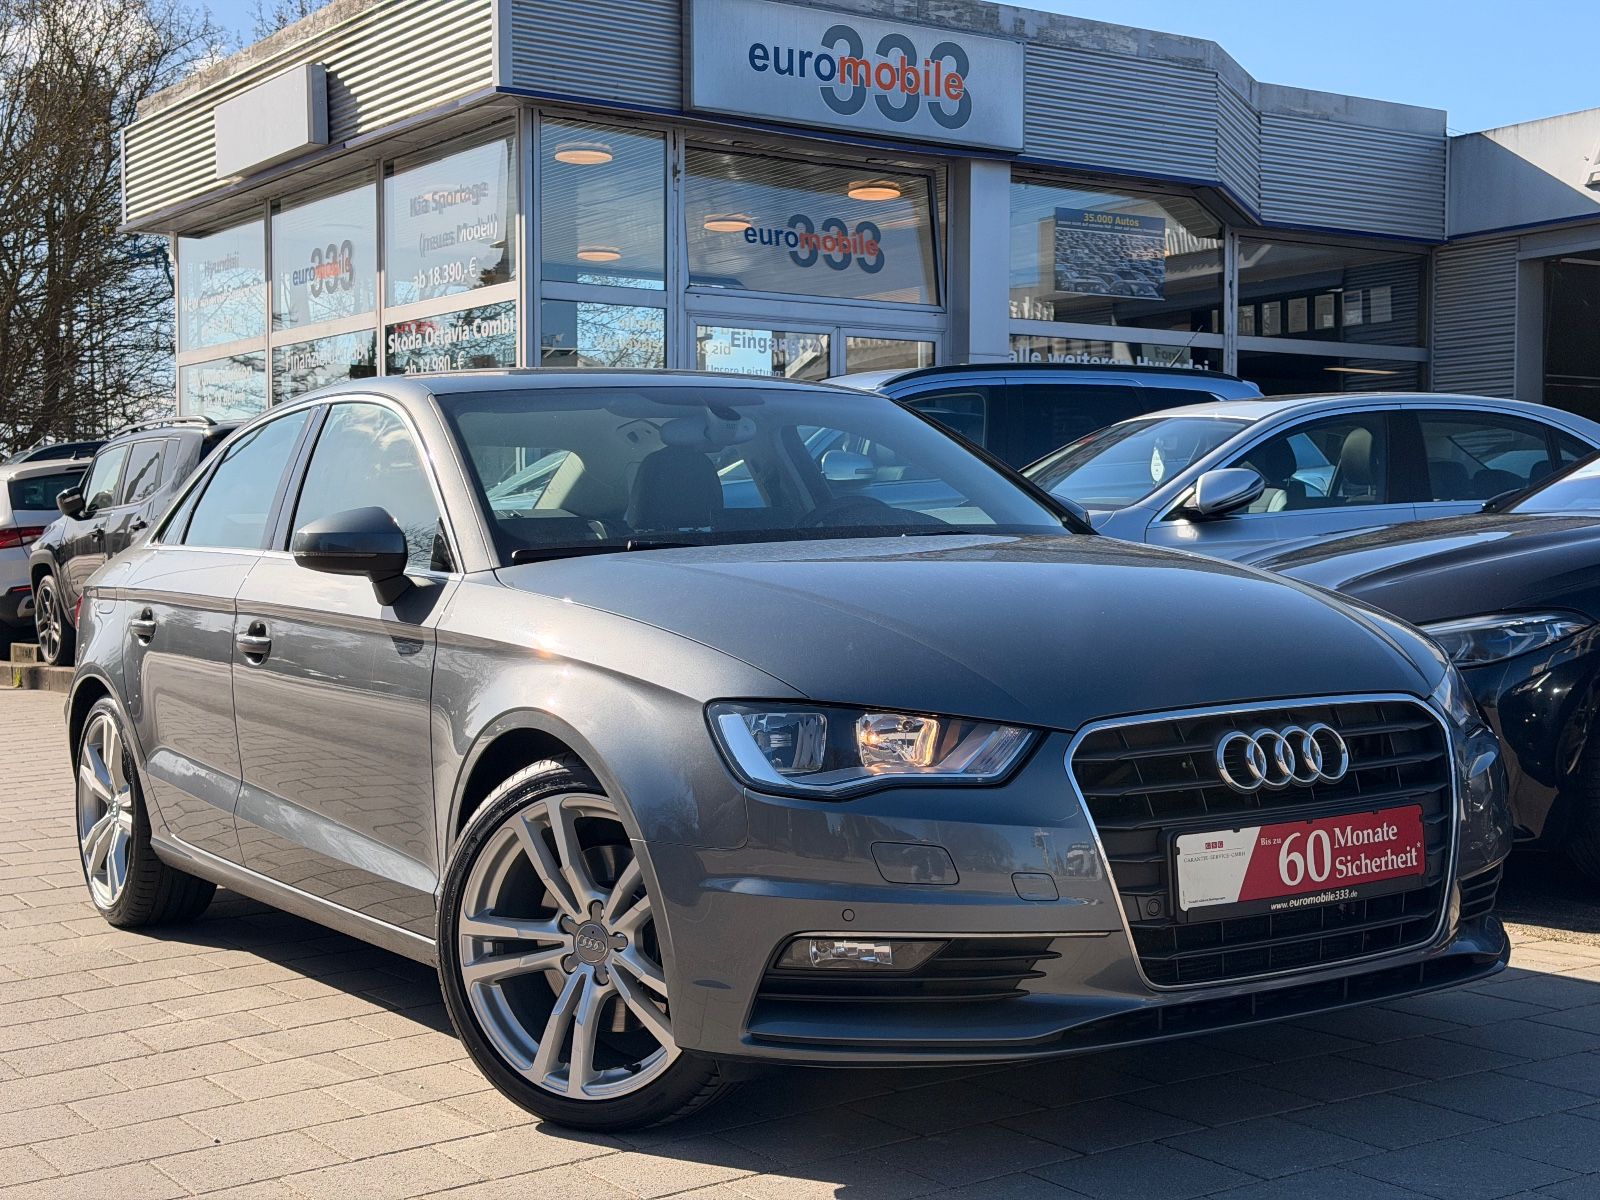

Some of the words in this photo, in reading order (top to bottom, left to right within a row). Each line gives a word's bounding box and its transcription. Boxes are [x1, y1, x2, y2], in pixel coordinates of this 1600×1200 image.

[748, 42, 964, 101] euromobile
[819, 24, 972, 129] 333
[1083, 213, 1113, 224] 35.000
[1115, 216, 1139, 227] Autos
[744, 226, 880, 257] euromobile
[787, 214, 885, 274] 333
[413, 269, 426, 289] ab
[425, 320, 470, 347] Octavia
[473, 312, 514, 338] Combi
[1260, 837, 1272, 846] Bis
[1272, 837, 1282, 845] zu
[1333, 822, 1398, 849] Monate
[1278, 829, 1332, 887] 60
[1270, 889, 1358, 910] www.euromobile333.de
